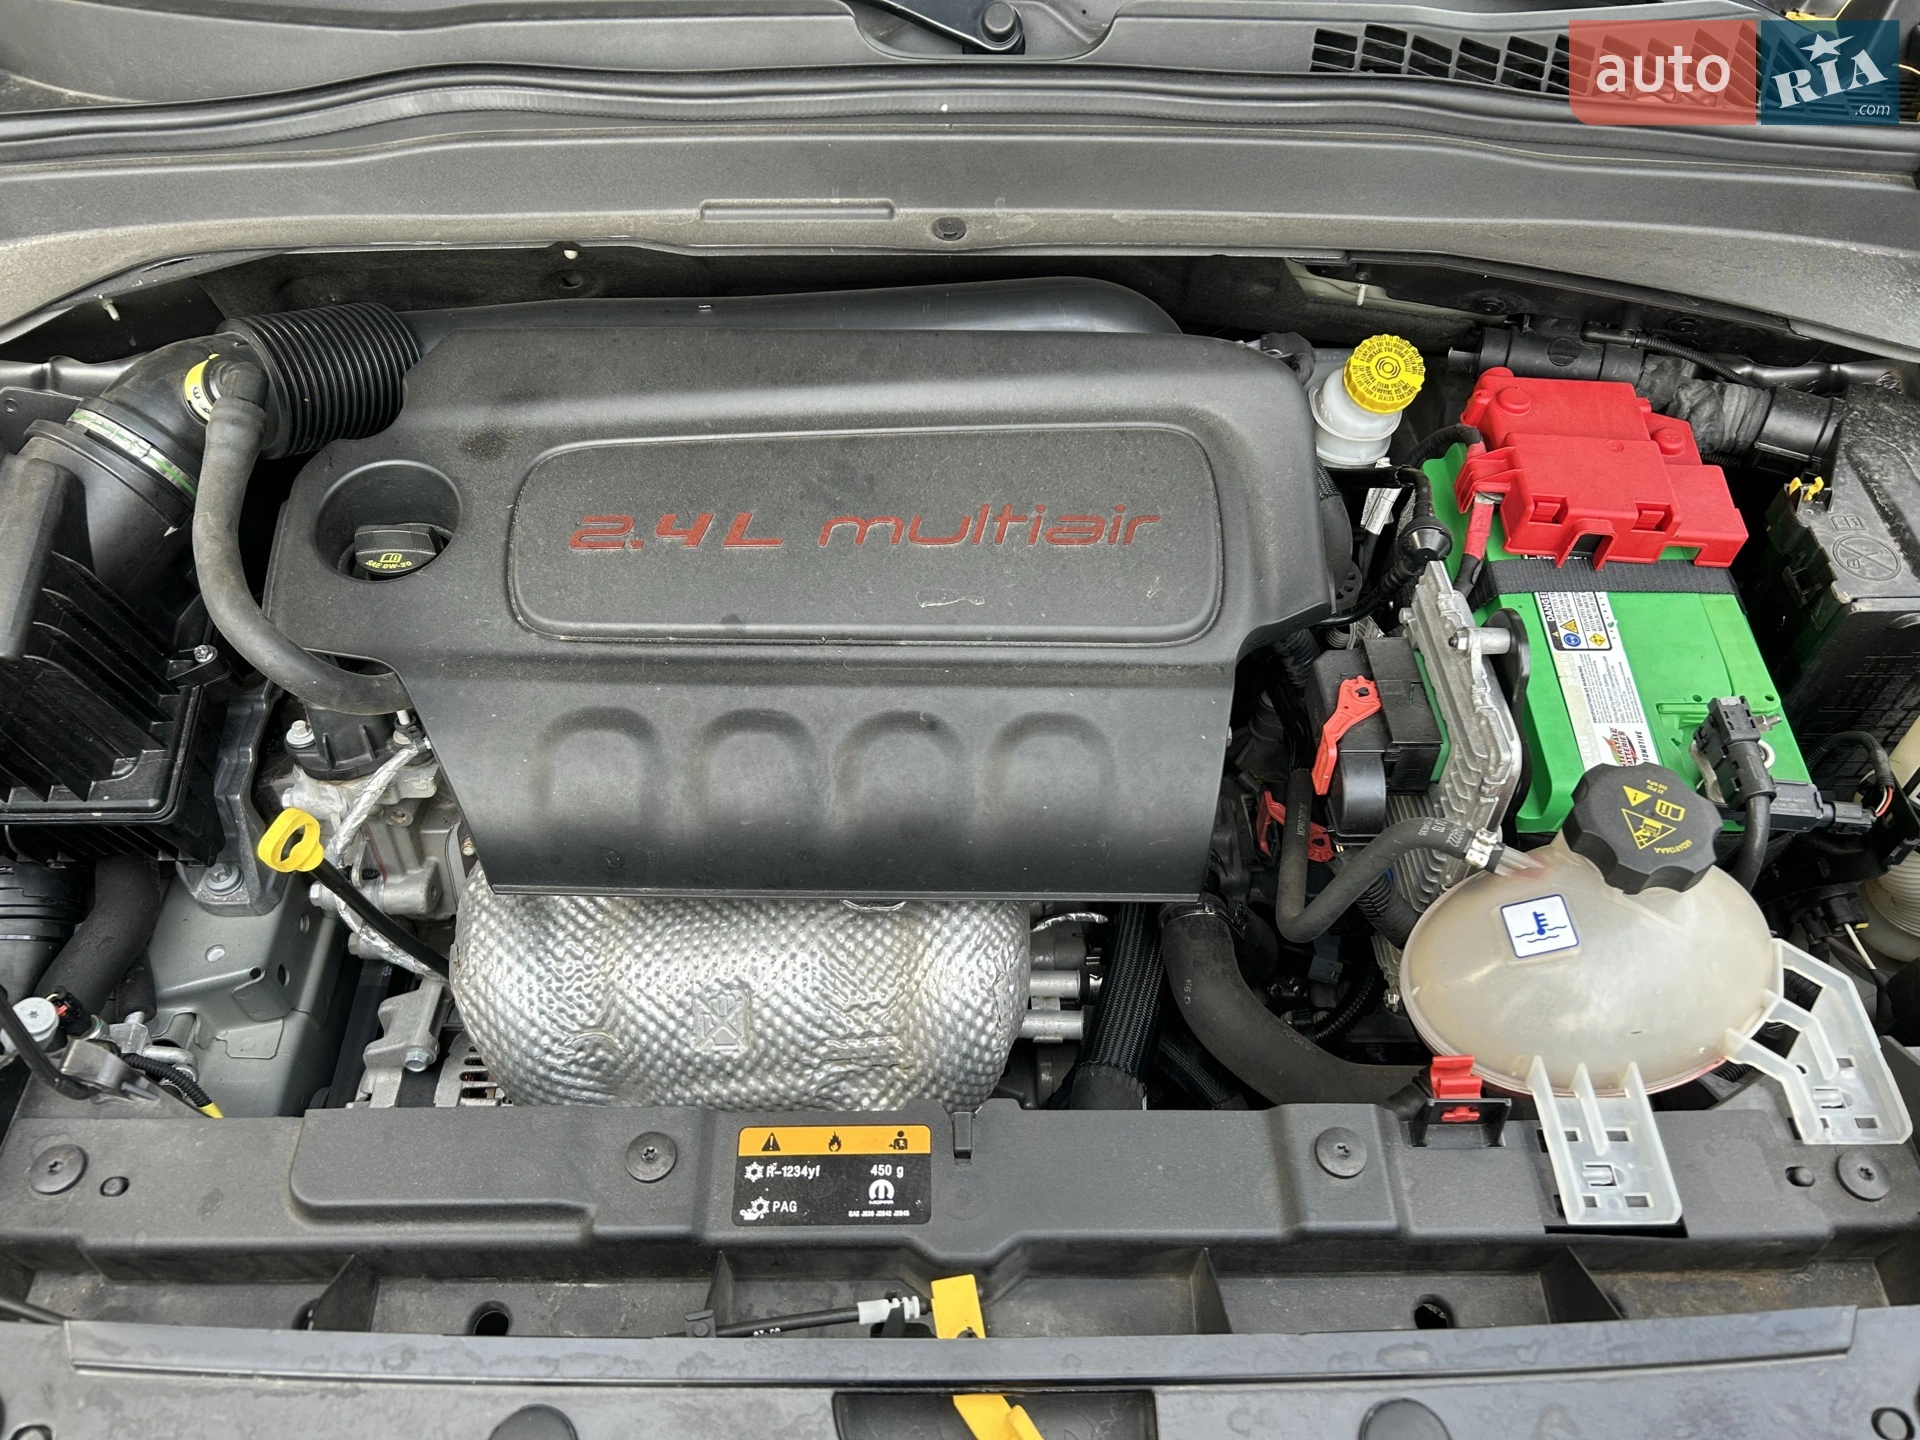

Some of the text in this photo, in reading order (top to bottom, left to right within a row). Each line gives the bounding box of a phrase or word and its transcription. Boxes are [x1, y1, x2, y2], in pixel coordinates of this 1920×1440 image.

[570, 503, 1160, 550] 2.4L multiair
[366, 560, 412, 569] SAE 0W-20
[1578, 666, 1587, 687] WARNING
[1586, 694, 1598, 722] PROPOSITION
[1610, 728, 1626, 766] TERSTATE
[1618, 731, 1633, 765] ATTERIES
[1635, 731, 1649, 761] TOMOTIVE
[766, 1164, 904, 1179] R-1234yf 450 g
[772, 1201, 797, 1212] PAG
